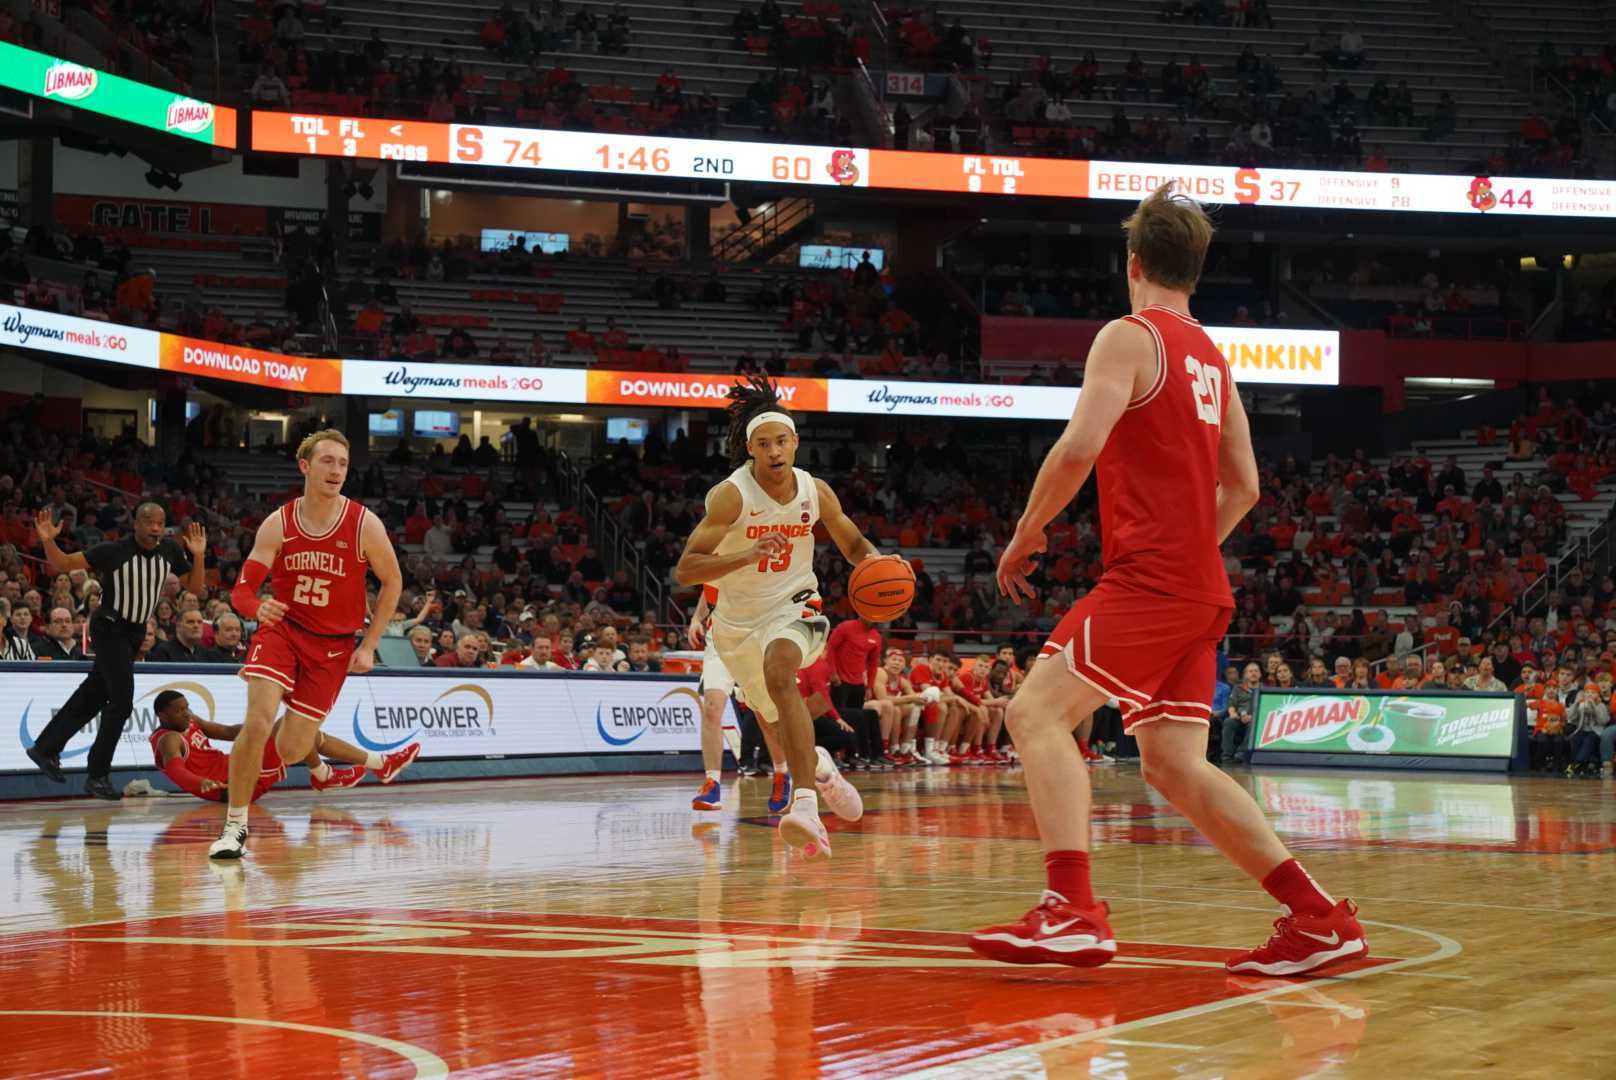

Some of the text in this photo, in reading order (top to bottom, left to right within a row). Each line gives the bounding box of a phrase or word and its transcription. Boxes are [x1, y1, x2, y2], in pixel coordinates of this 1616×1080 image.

[45, 70, 93, 93] LIBMAN
[888, 75, 922, 93] 314
[167, 105, 209, 127] LIBMAN
[291, 116, 365, 138] TOL FL
[306, 136, 357, 156] 1 3
[380, 143, 428, 161] POSS
[503, 139, 543, 165] 74
[595, 144, 671, 172] 1:46
[693, 157, 734, 174] 2ND
[772, 155, 812, 181] 60
[962, 157, 1025, 177] FL TOL
[1003, 177, 1016, 193] 2
[1270, 180, 1301, 201] 37
[1391, 196, 1411, 208] 28
[1499, 189, 1534, 209] 44
[93, 200, 192, 232] GATE
[2, 311, 128, 351] Wegmans meals 2GO
[183, 346, 309, 382] DOWNLOAD TODAY
[1216, 342, 1332, 371] UNKIN'
[382, 366, 544, 394] Wegmans meals 2GO
[619, 379, 731, 400] DOWNLOAD
[866, 384, 1014, 411] Wegmans meals 2GO
[1184, 354, 1222, 432] 20
[283, 551, 347, 577] CORNELL
[757, 543, 794, 573] 13
[293, 574, 331, 608] 25
[374, 705, 480, 730] EMPOWER
[613, 706, 695, 727] EMPOWER
[1262, 700, 1362, 745] LIBMAN
[1440, 708, 1512, 737] TORNADO
